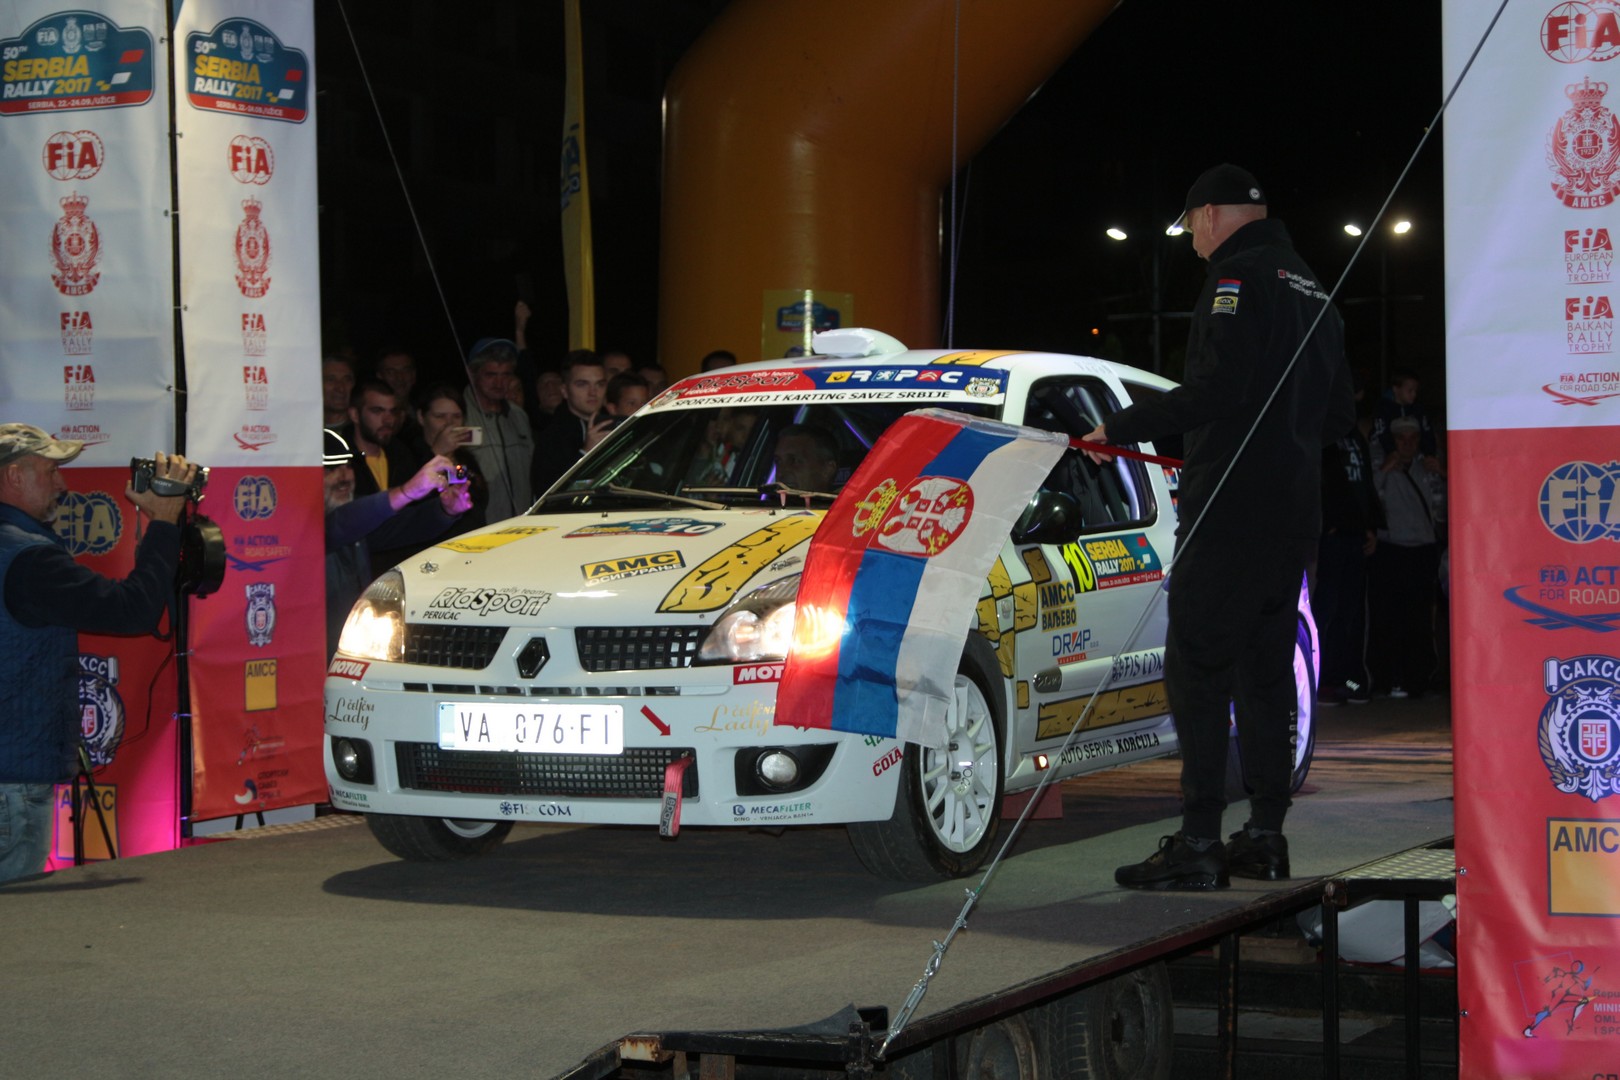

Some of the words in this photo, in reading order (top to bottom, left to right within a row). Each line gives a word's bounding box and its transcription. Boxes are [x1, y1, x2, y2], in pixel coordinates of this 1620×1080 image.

[3, 55, 90, 82] SERBIA
[194, 54, 260, 84] SERBIA
[3, 80, 55, 98] RALLY
[54, 77, 92, 94] 2017
[194, 77, 236, 96] RALLY
[235, 84, 263, 100] 2017
[1565, 252, 1613, 262] EUROPEAN
[1566, 261, 1612, 274] RALLY
[1568, 272, 1611, 282] TROPHY
[1567, 321, 1613, 332] BALKAN
[1567, 331, 1613, 344] RALLY
[1568, 343, 1612, 353] TROPHY
[1578, 371, 1620, 383] ACTION
[1575, 384, 1600, 392] ROAD
[672, 395, 734, 407] SPORTSKI
[739, 395, 769, 404] AUTO
[783, 391, 845, 401] KARTING
[849, 391, 894, 400] SAVEZ
[896, 390, 950, 399] SRBIJE
[72, 425, 100, 433] ACTION
[663, 524, 716, 534] 10
[248, 536, 279, 546] ACTION
[1085, 538, 1130, 560] SERBIA
[1063, 541, 1094, 593] 10
[1094, 559, 1120, 576] RALLY
[1120, 557, 1136, 572] 2017
[499, 587, 519, 595] rally
[1540, 589, 1565, 600] FOR
[1569, 588, 1620, 605] ROAD
[430, 586, 552, 616] RidSport
[1053, 629, 1091, 656] DRAP
[330, 660, 366, 677] MOTUL
[328, 697, 369, 731] Lady
[694, 704, 769, 736] Lady
[461, 712, 490, 743] VA
[1061, 747, 1083, 765] AUTO
[1083, 739, 1114, 759] SERVIS
[872, 747, 903, 777] COLA
[539, 804, 571, 816] COM
[751, 802, 812, 814] MECAFILTER
